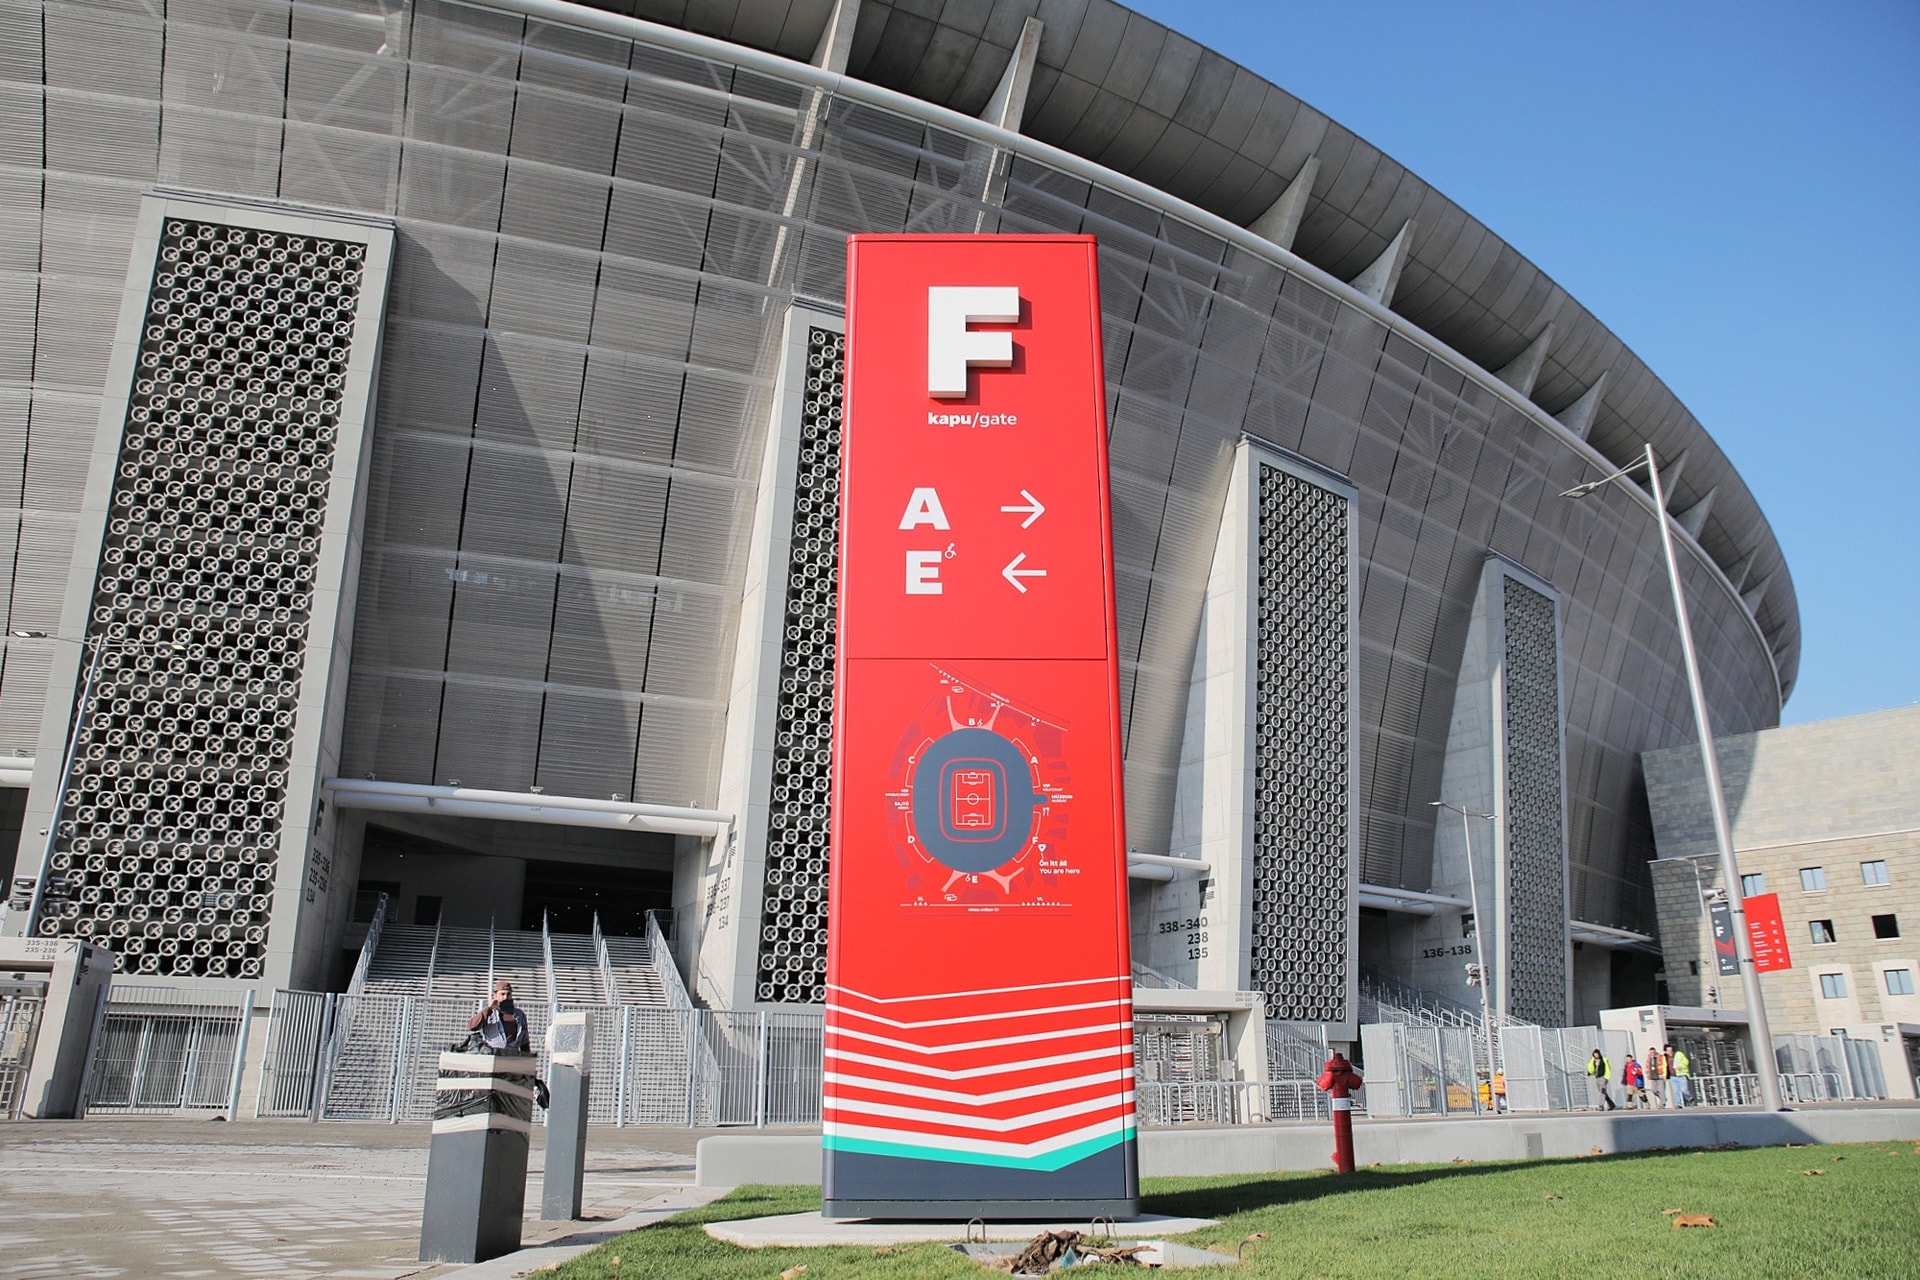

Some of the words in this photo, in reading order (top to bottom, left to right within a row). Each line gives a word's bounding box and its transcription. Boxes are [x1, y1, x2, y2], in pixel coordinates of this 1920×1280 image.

[928, 286, 1020, 399] F
[928, 412, 1018, 428] kapu/gate
[898, 487, 951, 530] A
[905, 550, 943, 595] E
[968, 718, 975, 726] B
[908, 756, 915, 764] C
[1030, 756, 1038, 764] A
[908, 835, 915, 843] D
[1032, 836, 1039, 844] F
[1159, 917, 1208, 934] 338-340
[1715, 926, 1724, 937] F
[1187, 932, 1209, 945] 238
[1188, 947, 1208, 960] 135
[1423, 945, 1472, 959] 136-138
